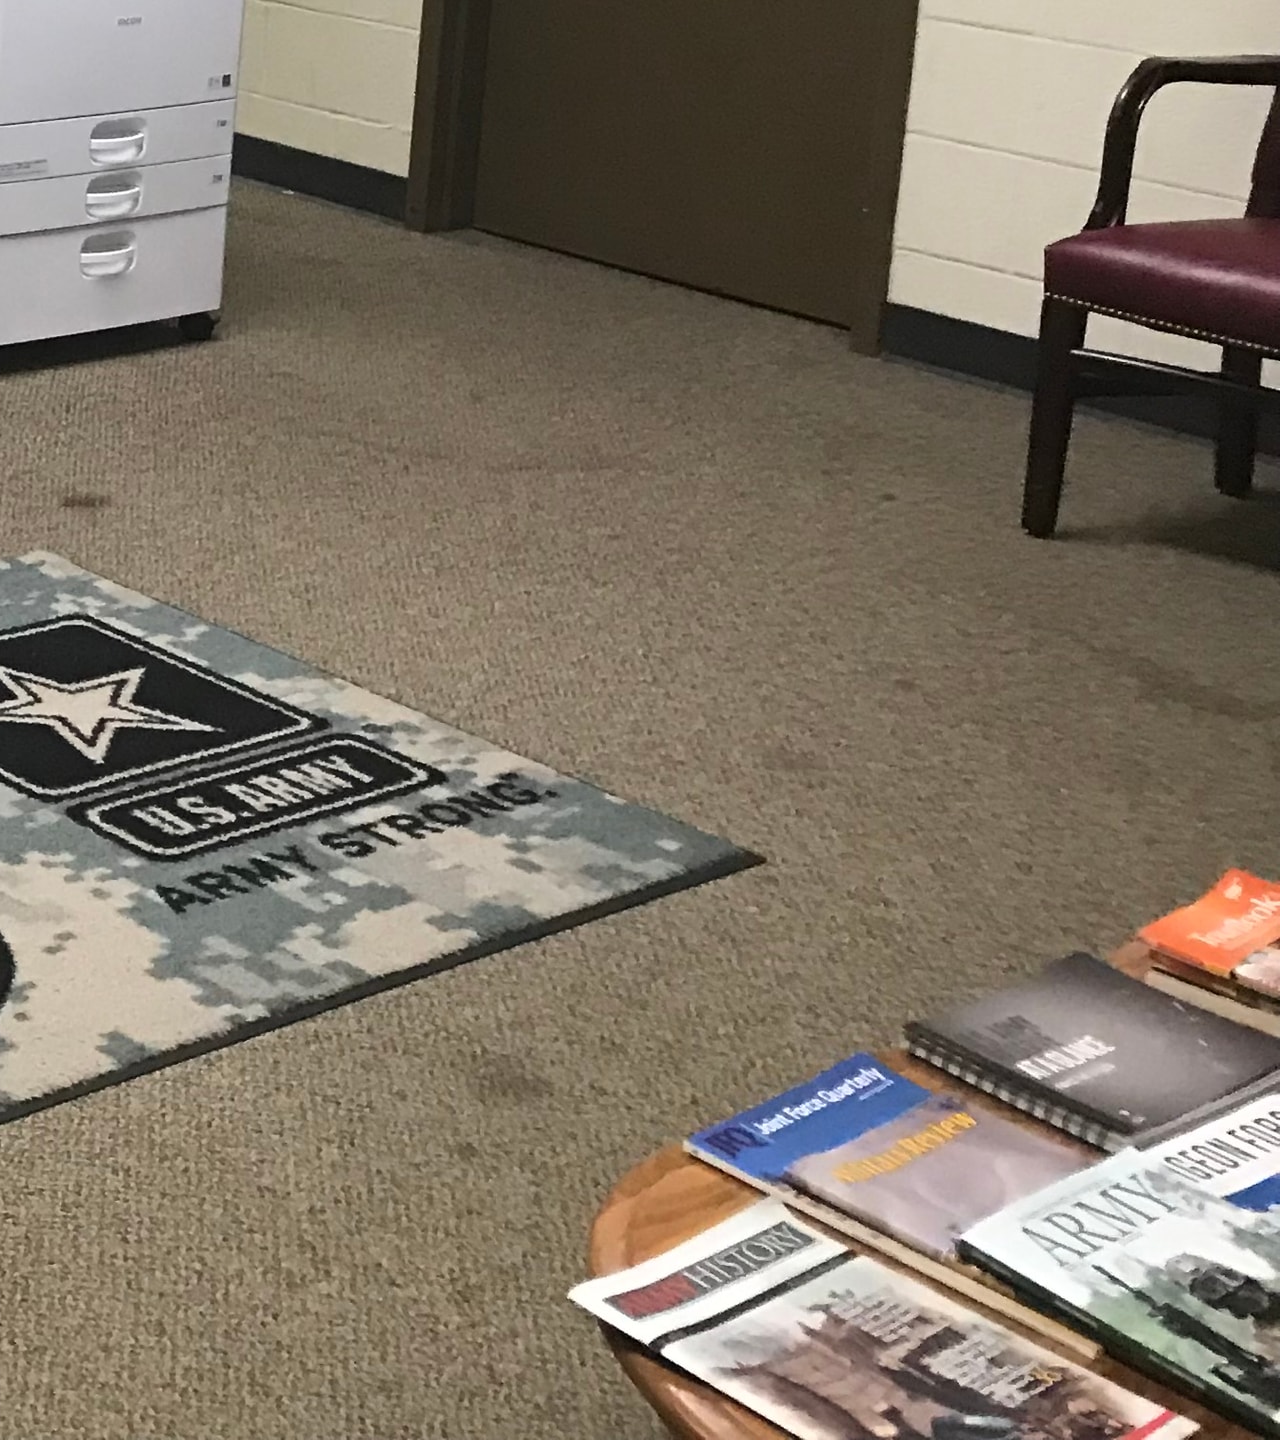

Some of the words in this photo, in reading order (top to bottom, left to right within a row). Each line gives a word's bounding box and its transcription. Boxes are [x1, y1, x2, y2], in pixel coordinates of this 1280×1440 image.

[219, 755, 374, 813] ARMY
[154, 844, 319, 914] ARMY
[317, 772, 560, 858] STRONG.
[753, 1112, 790, 1136] Joint
[782, 1093, 827, 1122] Force
[816, 1066, 888, 1104] Quarterly
[895, 1111, 978, 1159] Review
[1162, 1137, 1259, 1183] IGEON
[1022, 1173, 1177, 1267] ARMY
[682, 1223, 803, 1290] HISTORY
